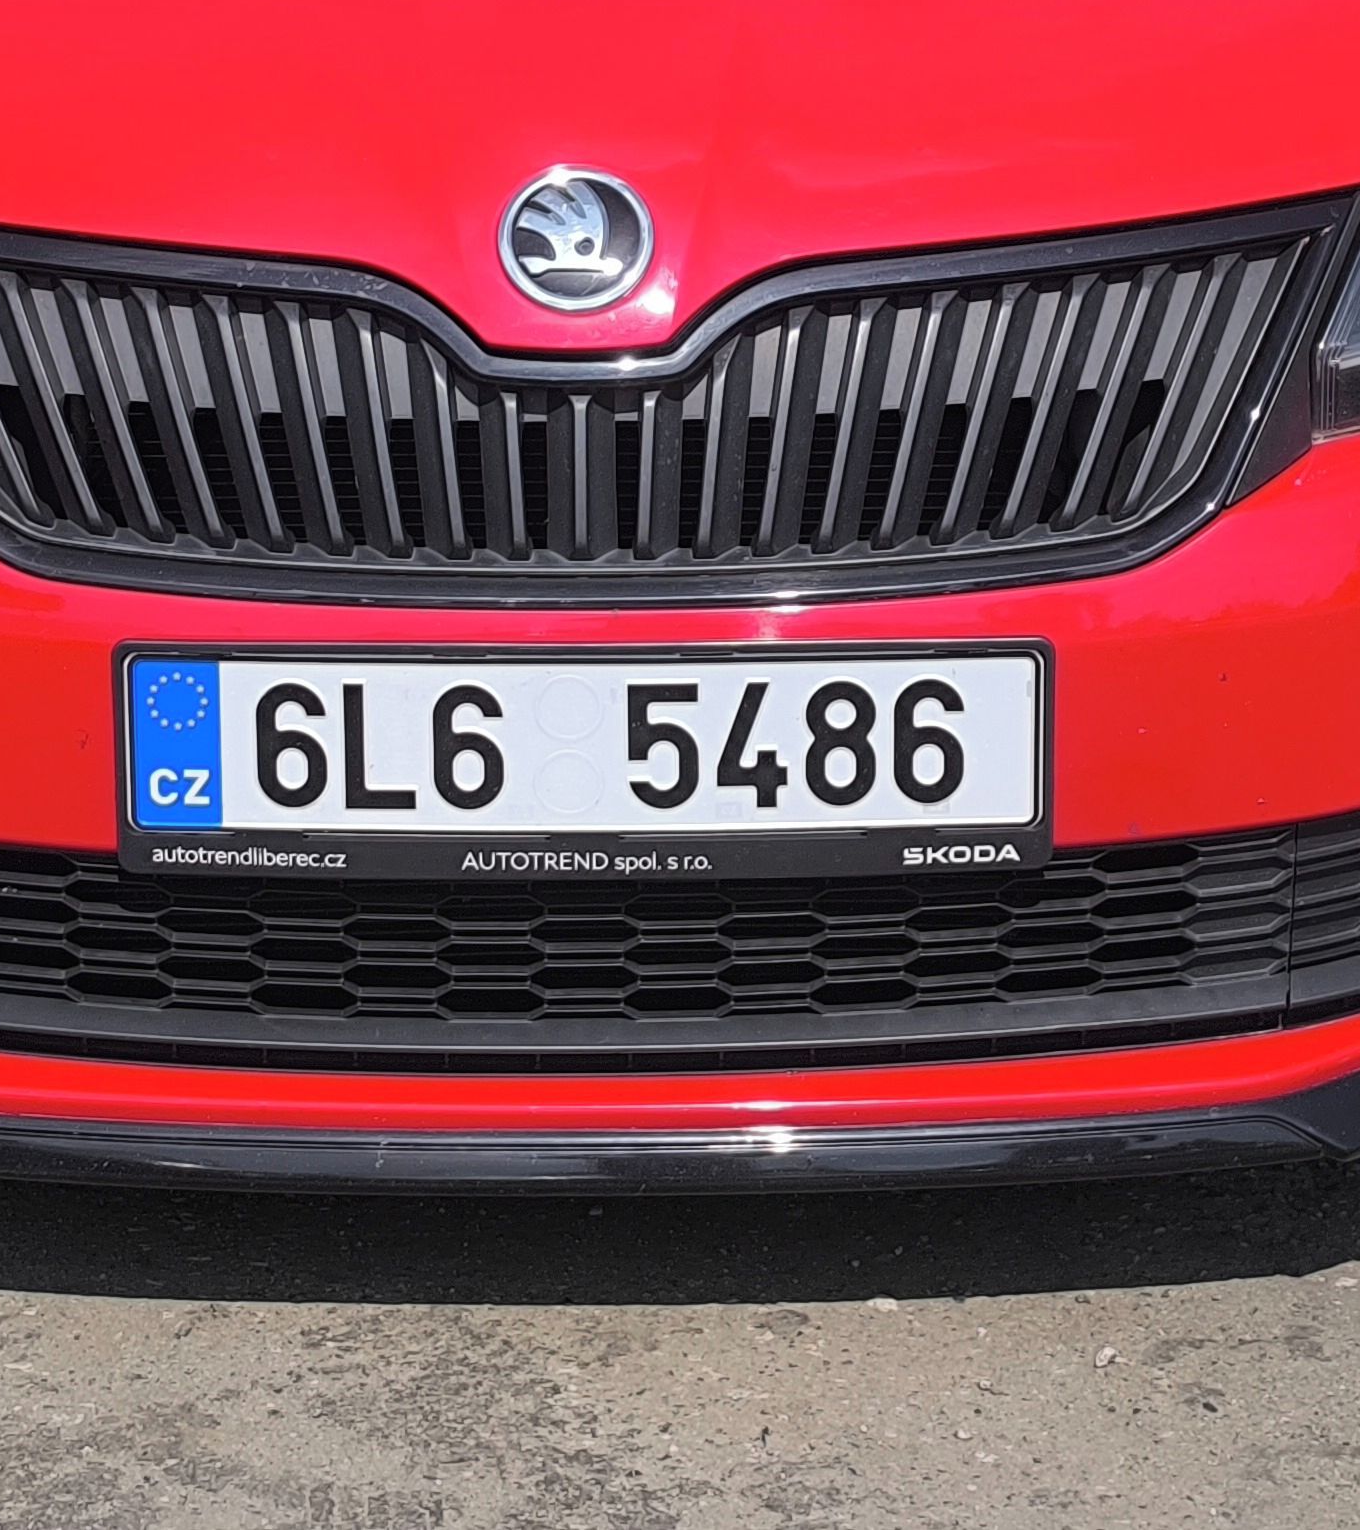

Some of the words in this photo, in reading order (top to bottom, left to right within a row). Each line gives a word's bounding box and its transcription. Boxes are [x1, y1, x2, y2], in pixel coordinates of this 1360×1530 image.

[254, 681, 505, 811] 6L6
[626, 678, 965, 811] 5486
[149, 767, 211, 806] CZ
[152, 847, 348, 869] autotrendliberec.cz
[461, 851, 609, 871] AUTOTREND
[613, 850, 662, 876] spol.
[667, 856, 679, 871] s
[683, 856, 713, 871] r.o.
